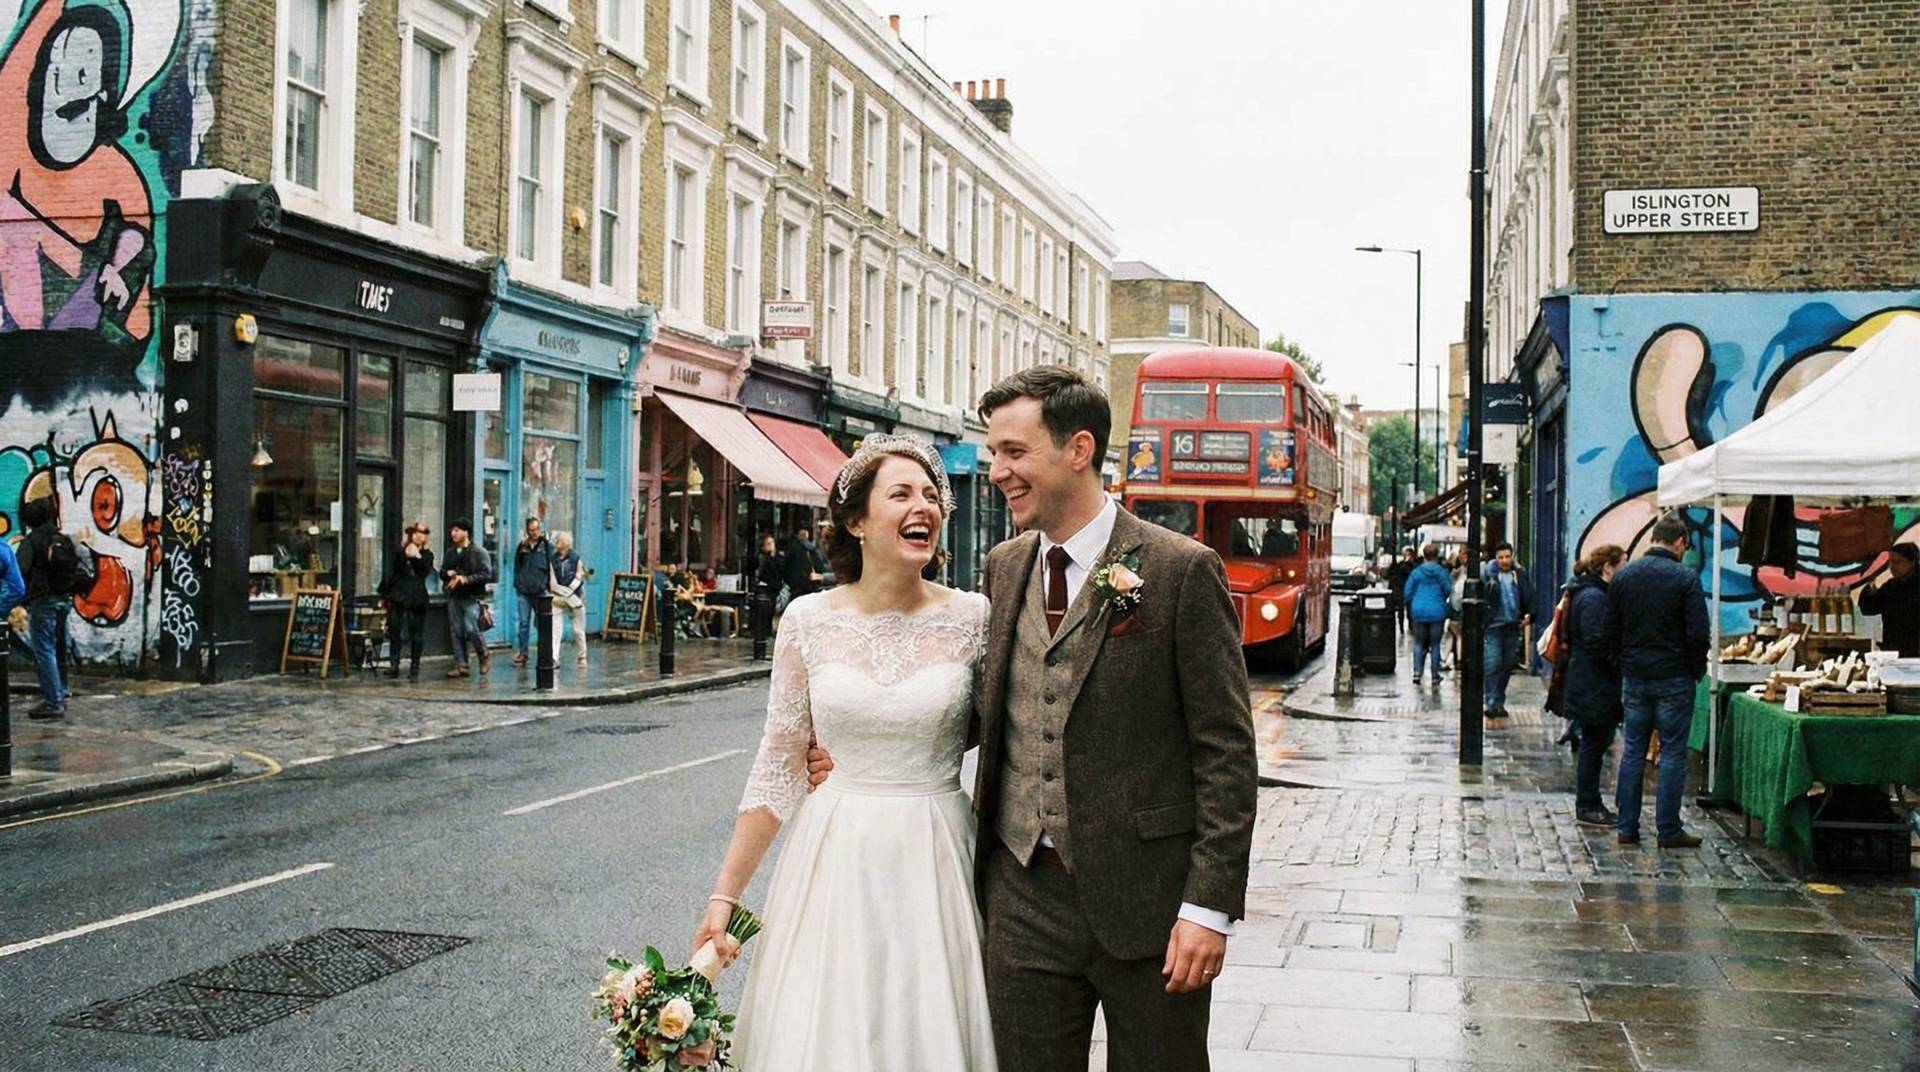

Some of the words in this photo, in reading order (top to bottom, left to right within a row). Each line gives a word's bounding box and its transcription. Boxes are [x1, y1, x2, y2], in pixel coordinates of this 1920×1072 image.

[1632, 193, 1730, 209] ISLINGTON
[1613, 213, 1671, 228] UPPER
[1680, 211, 1749, 227] STREET
